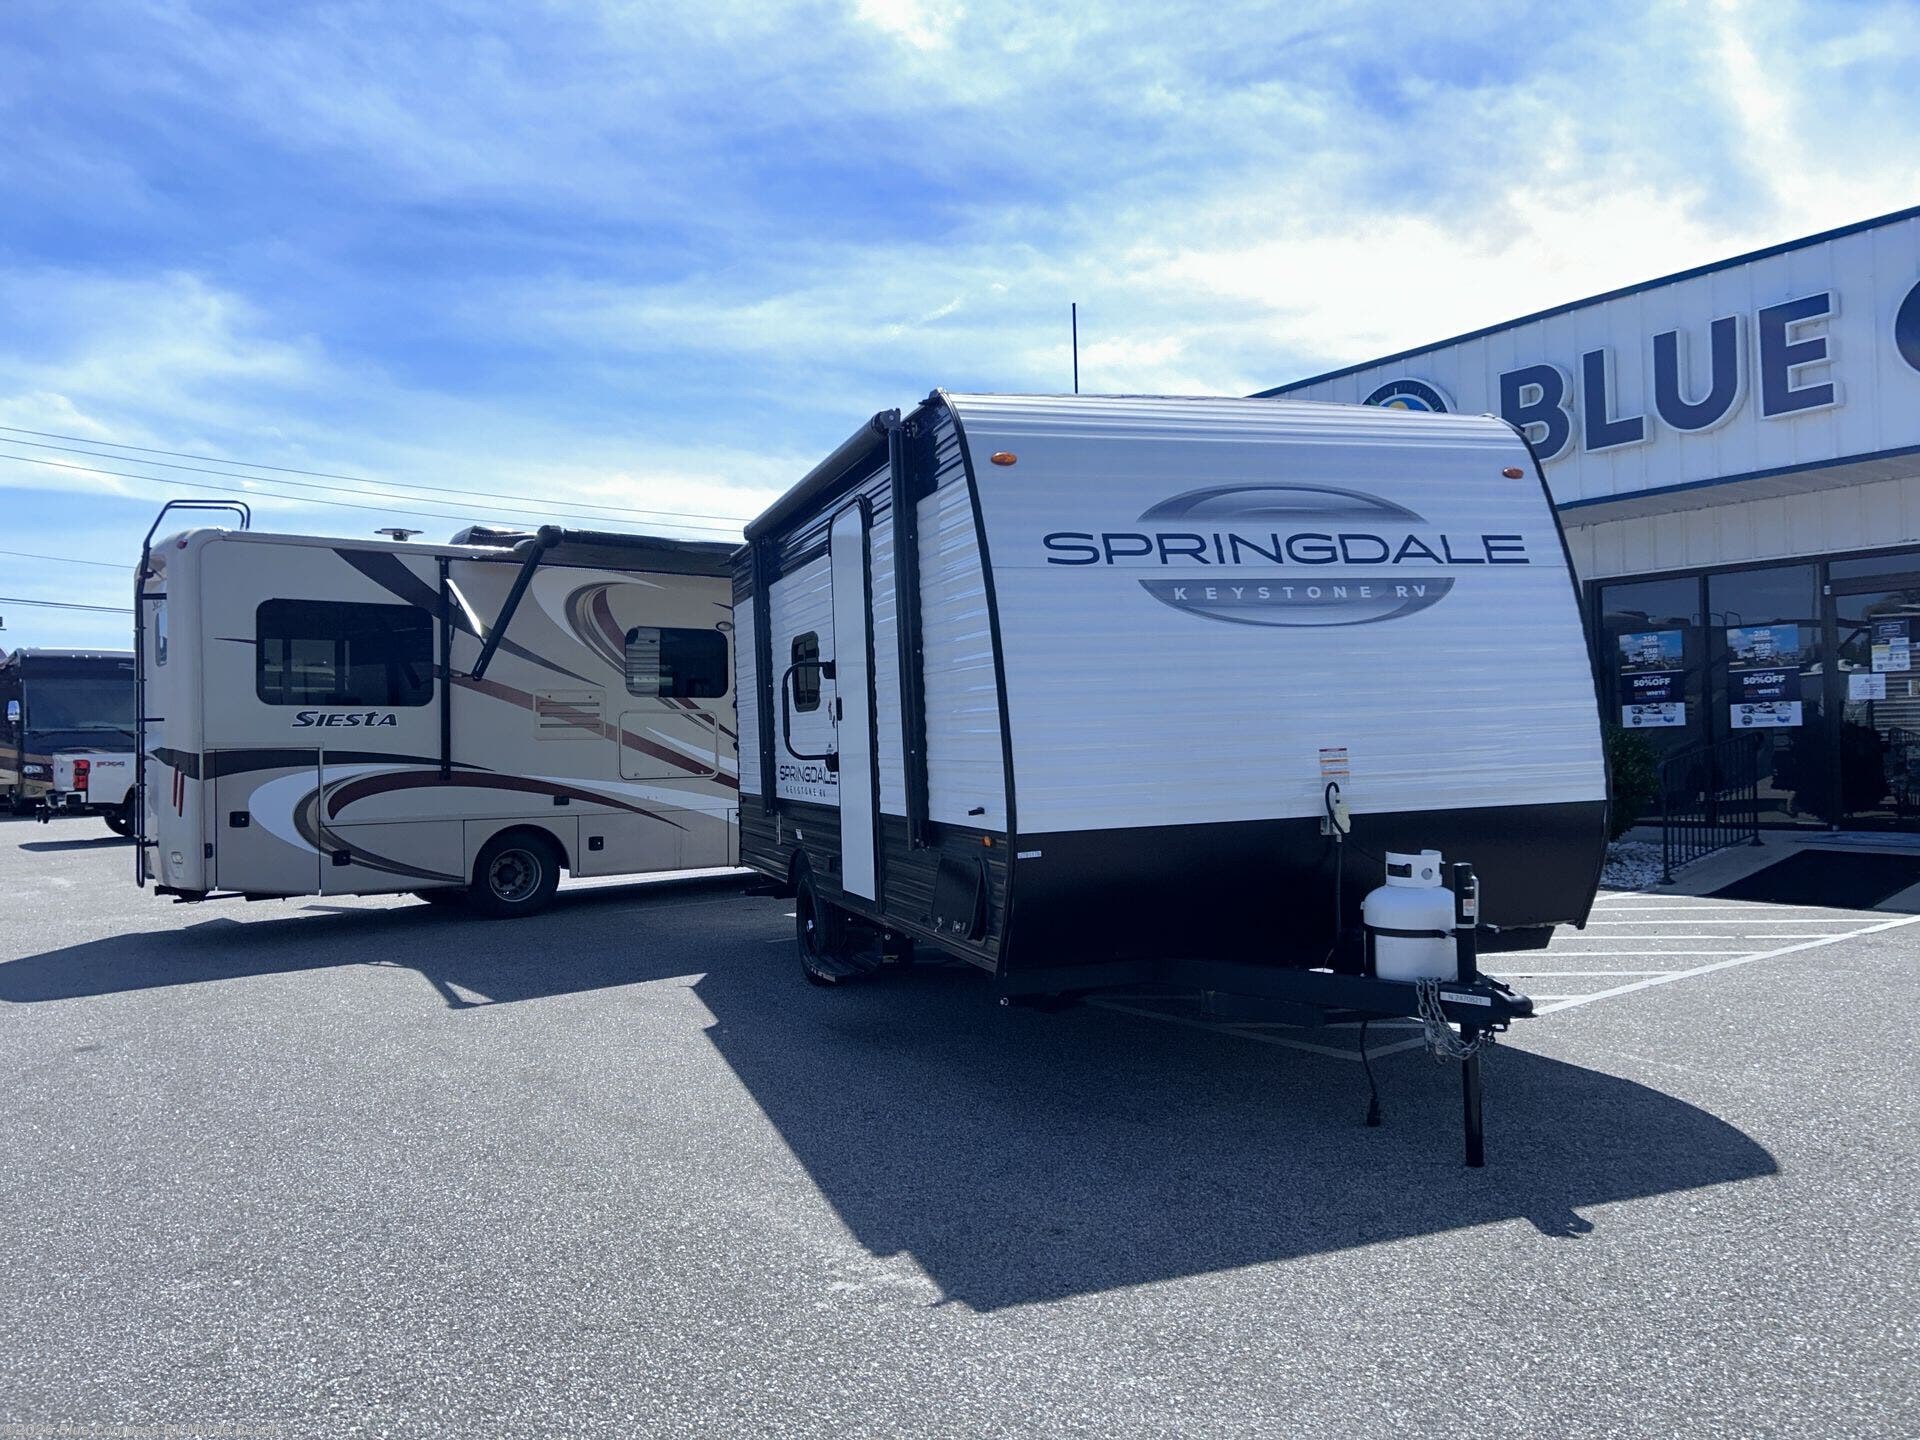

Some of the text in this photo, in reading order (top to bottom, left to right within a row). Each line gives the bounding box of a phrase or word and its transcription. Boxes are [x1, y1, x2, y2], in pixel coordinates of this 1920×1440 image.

[1499, 291, 1838, 461] BLUE
[1043, 532, 1531, 566] SPRINGDALE
[1173, 584, 1427, 601] KEYSTONE RV
[780, 765, 838, 785] SPRINGDALE
